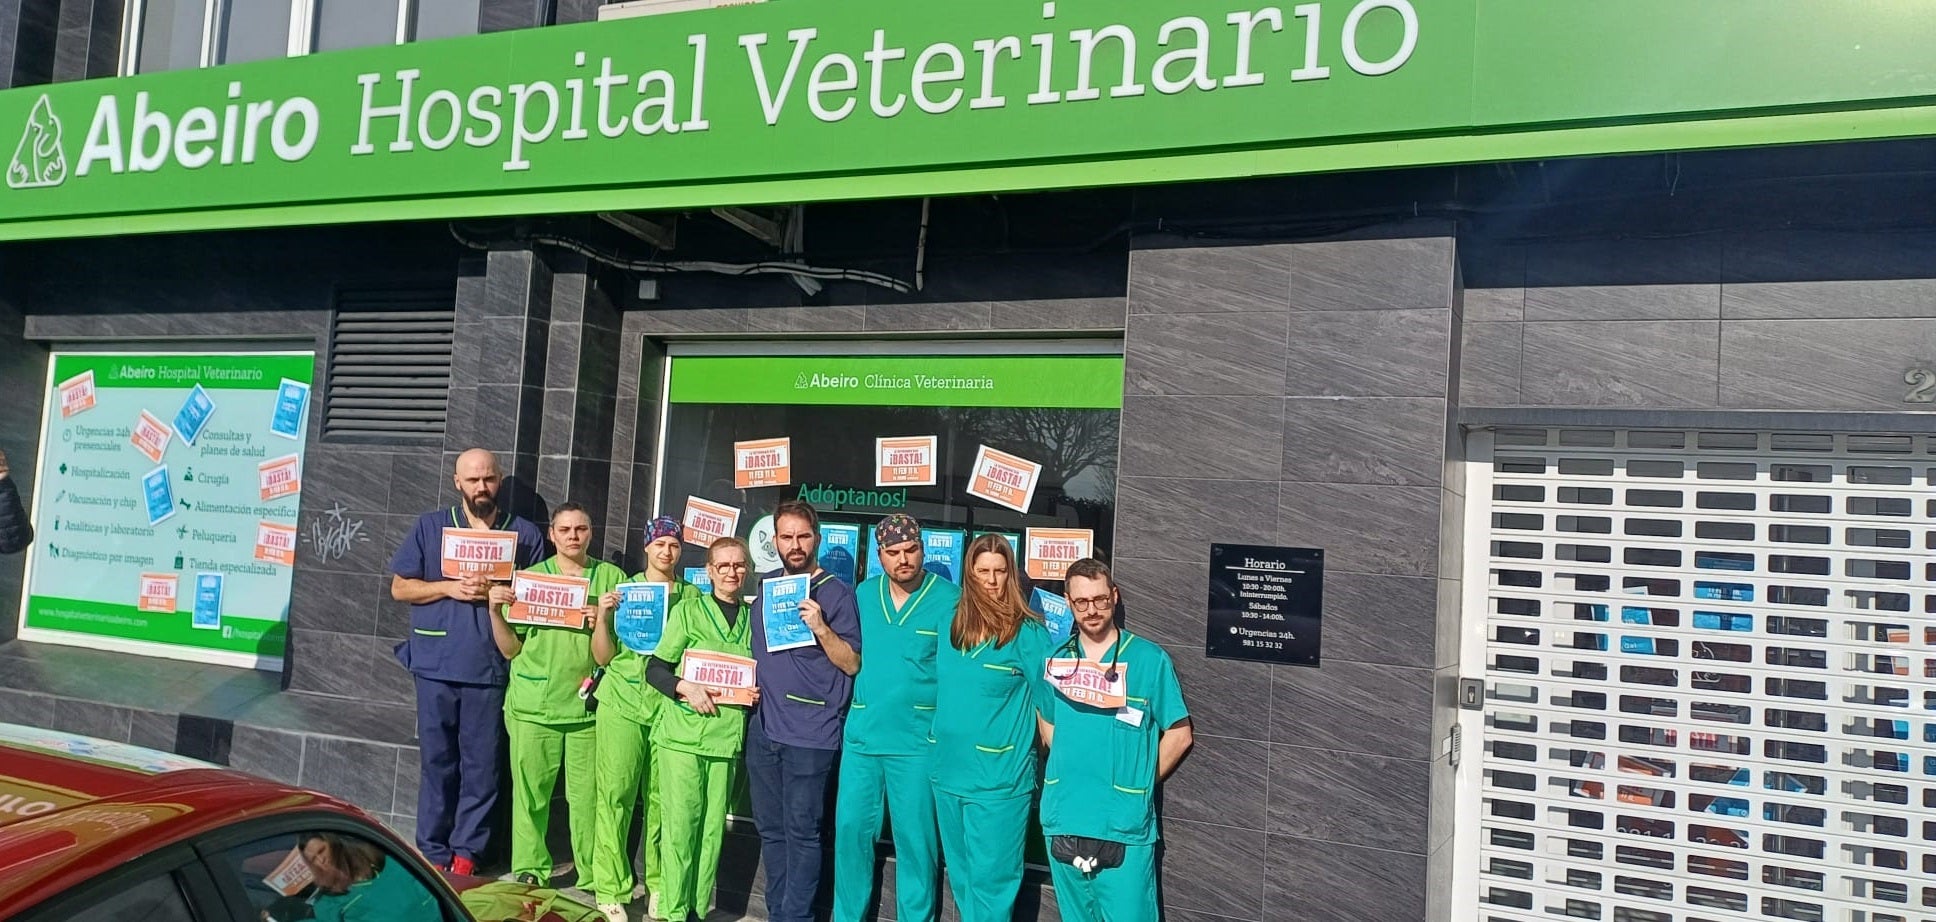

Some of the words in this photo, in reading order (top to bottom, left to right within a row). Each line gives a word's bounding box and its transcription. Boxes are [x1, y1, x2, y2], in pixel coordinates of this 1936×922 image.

[75, 82, 321, 178] Abeiro
[350, 34, 711, 172] Hospital
[738, 0, 1420, 126] Veterinario
[119, 365, 156, 379] Abeiro
[158, 366, 200, 383] Hospital
[203, 366, 264, 380] Veterinario
[809, 373, 859, 389] Abeiro
[864, 374, 911, 389] Clínica
[914, 374, 994, 389] Veterinaria
[202, 429, 245, 441] Consultas
[200, 443, 228, 457] planes
[229, 445, 240, 456] de
[241, 445, 266, 457] salud
[745, 453, 781, 469] ¡BASTA!
[890, 452, 923, 465] ¡BASTA!
[986, 466, 1023, 488] ¡BASTA!
[797, 483, 907, 509] Adóptanos!
[692, 515, 725, 535] ¡BASTA!
[455, 545, 503, 560] ¡BASTA!
[1039, 545, 1080, 559] ¡BASTA!
[189, 557, 218, 571] Tienda
[219, 561, 277, 576] especializada
[1244, 558, 1286, 570] Horario
[1237, 573, 1259, 581] Lunes
[1265, 575, 1293, 583] Viernes
[1242, 583, 1259, 591] 10:30
[525, 587, 574, 607] ¡BASTA!
[1248, 602, 1278, 611] Sábados
[1262, 613, 1285, 621] 14:00h.
[1238, 627, 1277, 638] Urgencias
[1278, 631, 1296, 640] 24h.
[695, 667, 744, 686] ¡BASTA!
[1072, 688, 1086, 698] FEB
